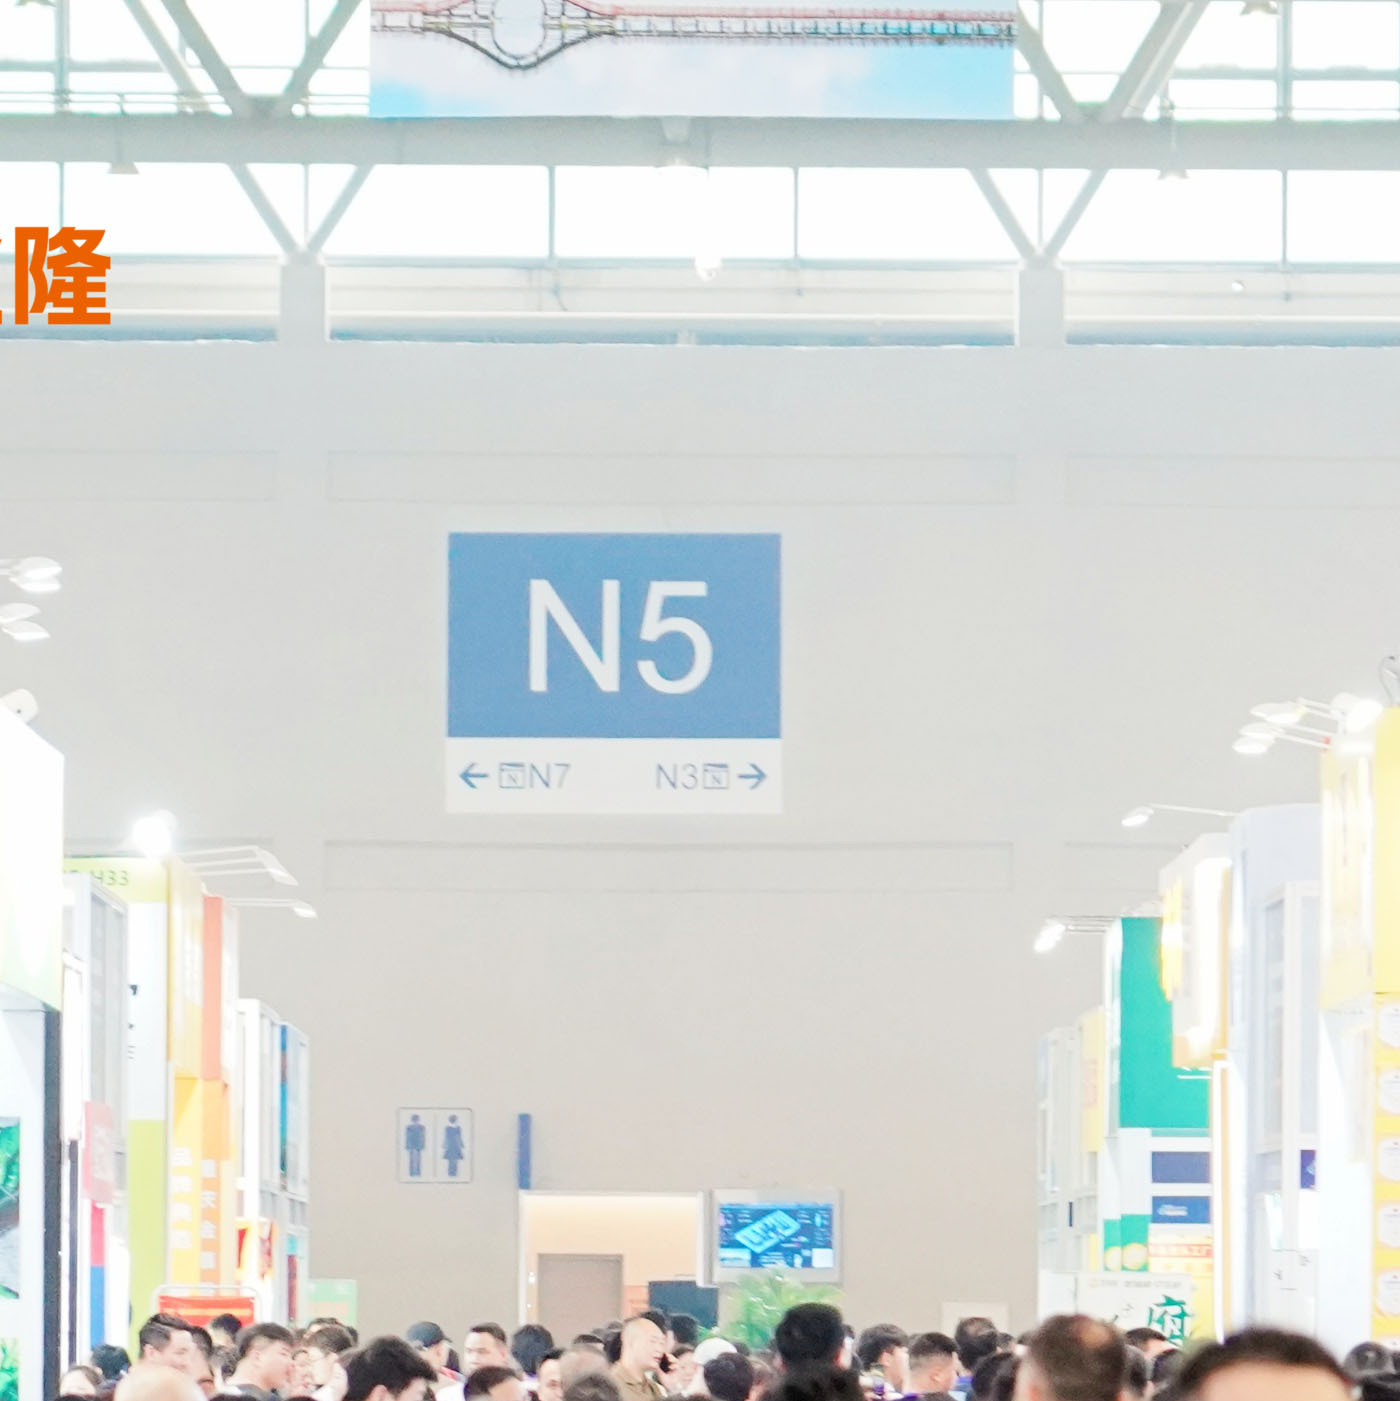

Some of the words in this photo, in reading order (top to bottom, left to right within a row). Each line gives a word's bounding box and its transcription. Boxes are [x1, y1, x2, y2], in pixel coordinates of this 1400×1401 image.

[528, 578, 713, 694] N5
[530, 762, 571, 789] N7
[656, 762, 698, 789] N3
